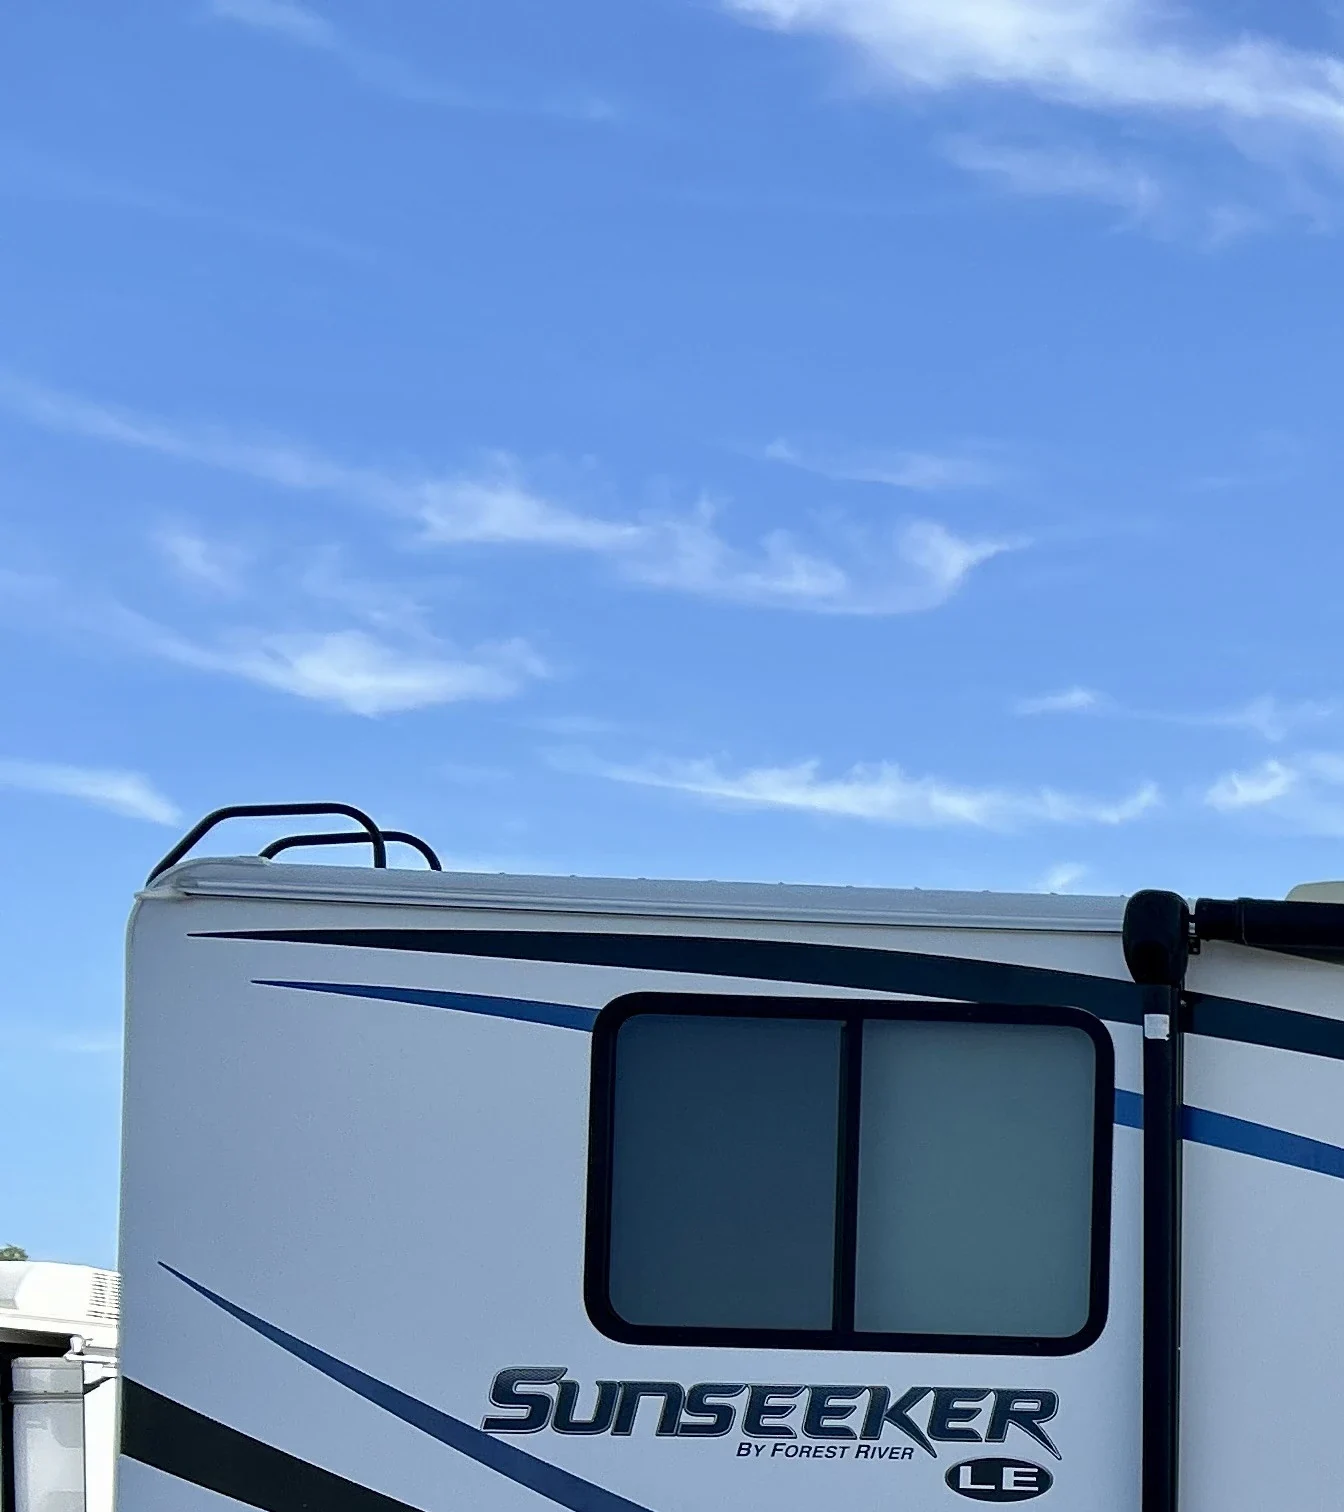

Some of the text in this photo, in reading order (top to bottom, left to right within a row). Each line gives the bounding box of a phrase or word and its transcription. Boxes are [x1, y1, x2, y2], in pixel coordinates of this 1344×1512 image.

[481, 1366, 1062, 1461] SUNSEEKER
[771, 1442, 850, 1459] FOREST
[855, 1444, 914, 1460] RIVER
[959, 1465, 1039, 1491] LE
